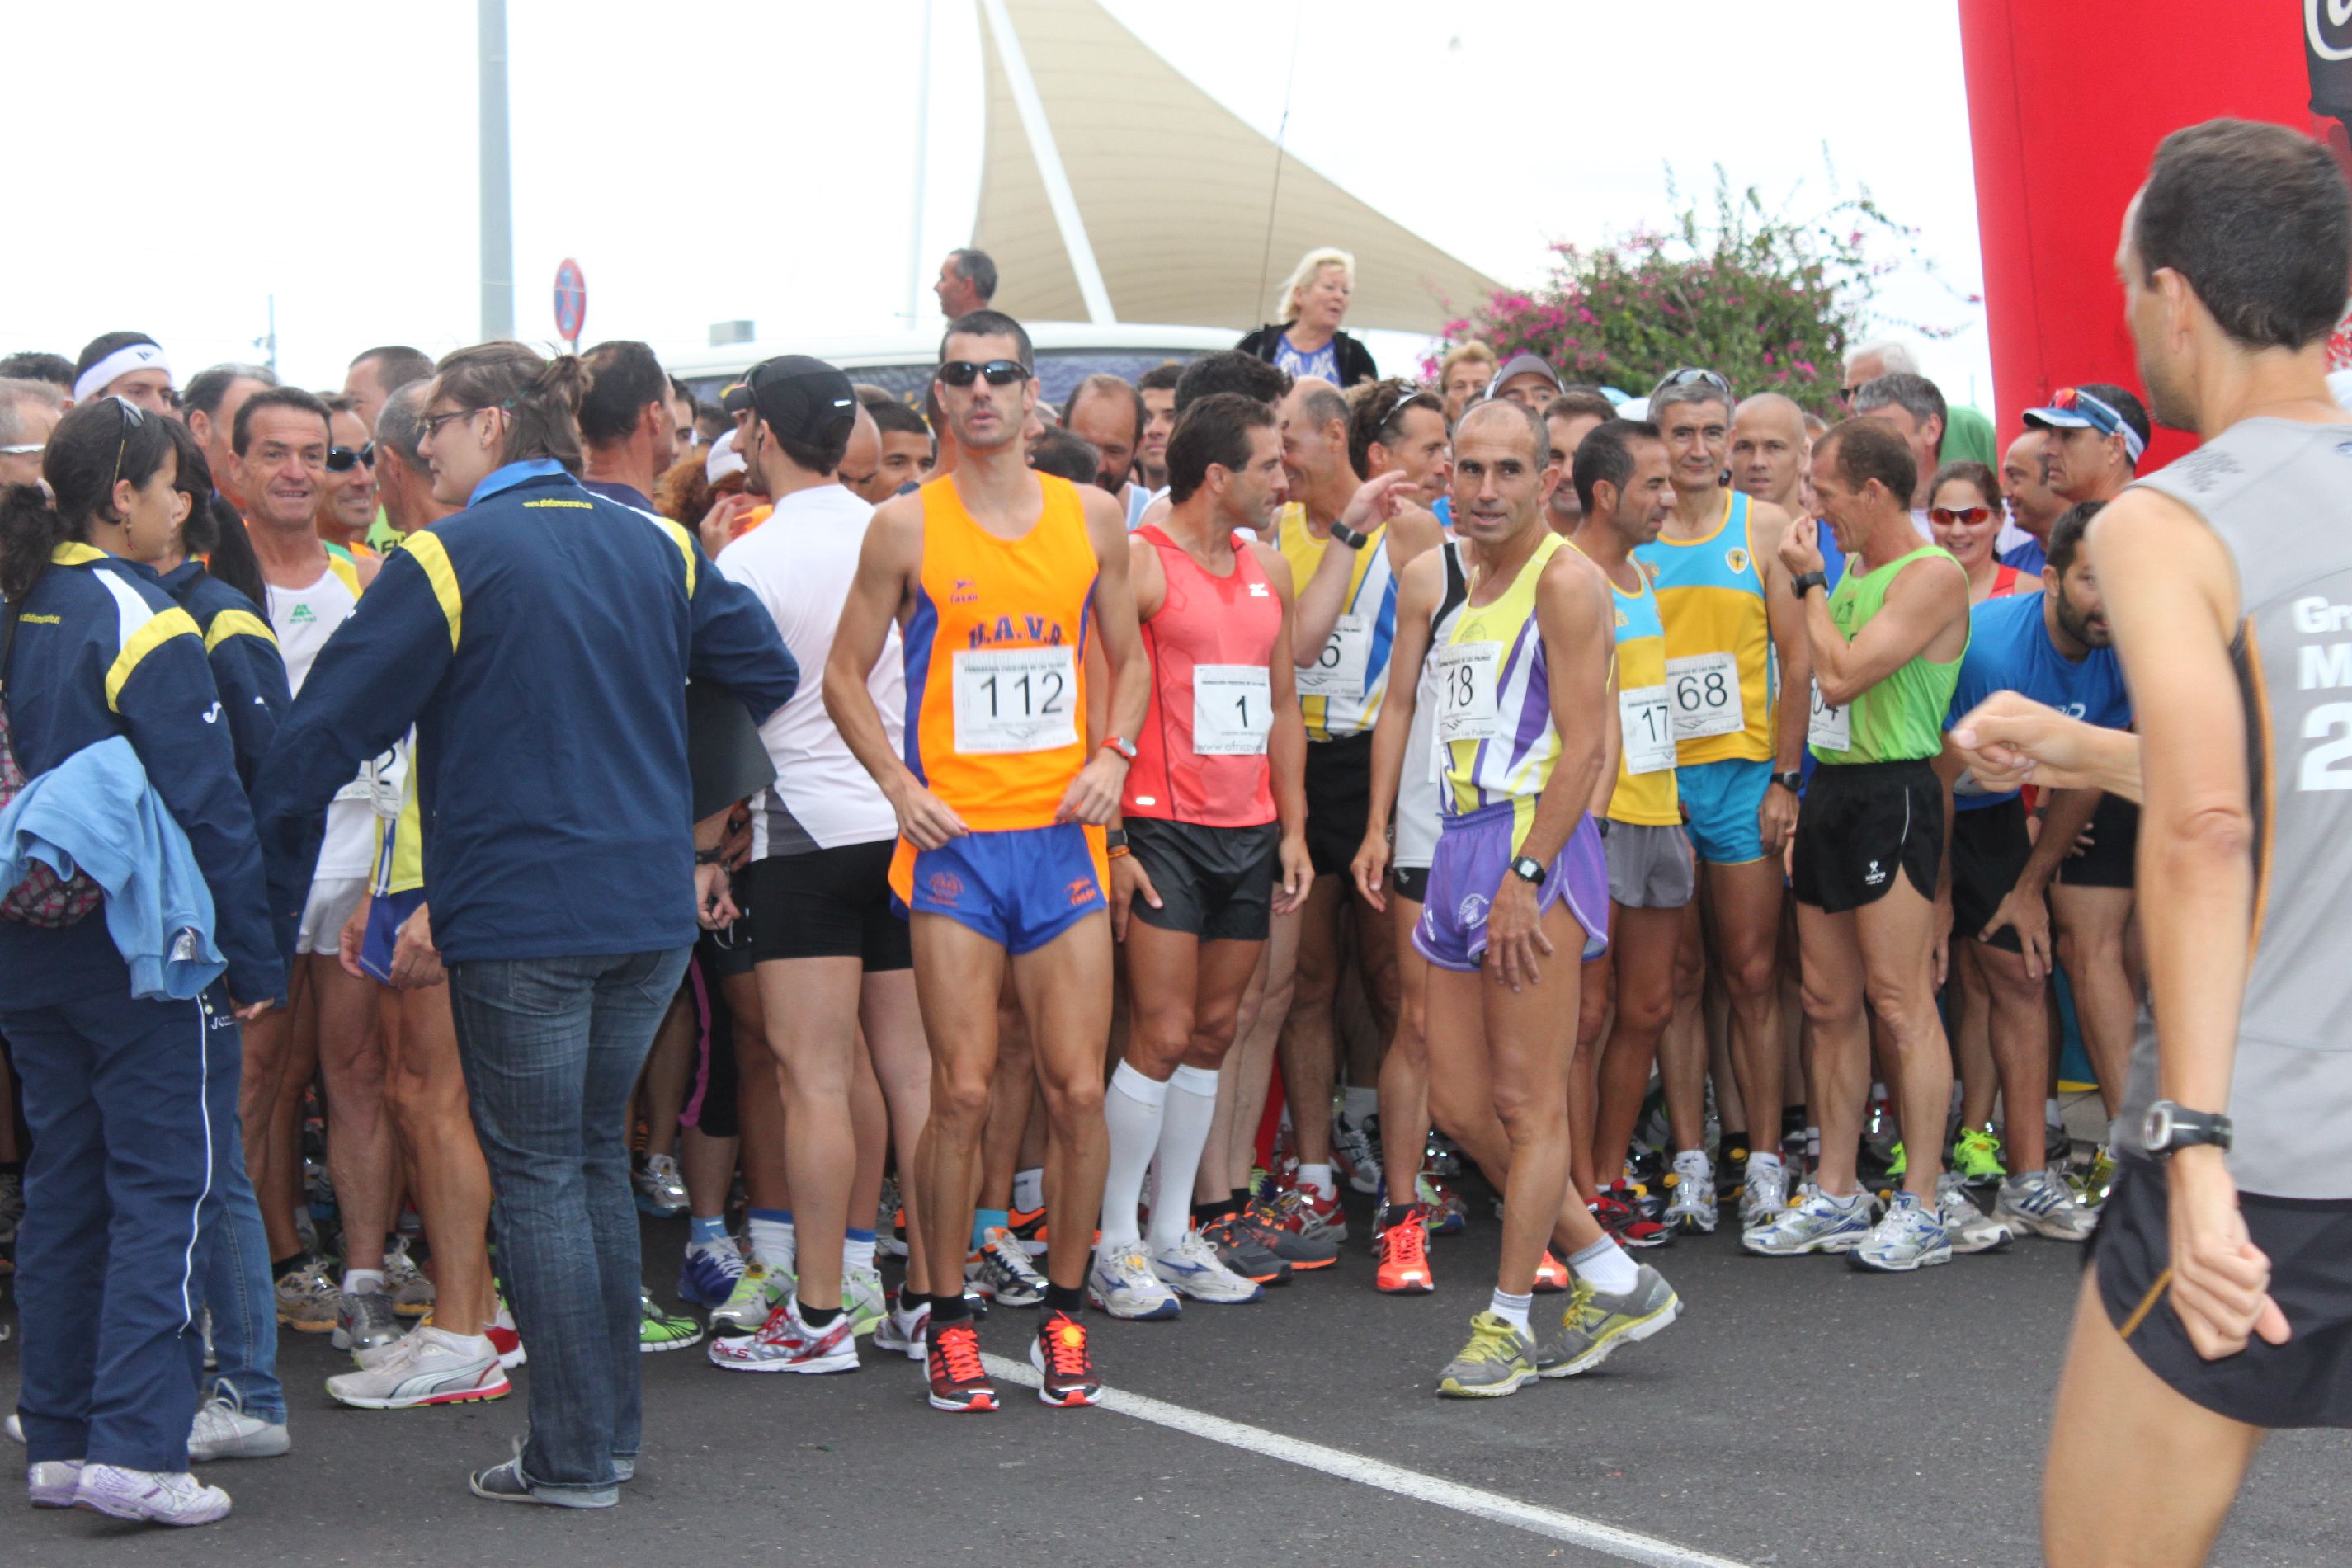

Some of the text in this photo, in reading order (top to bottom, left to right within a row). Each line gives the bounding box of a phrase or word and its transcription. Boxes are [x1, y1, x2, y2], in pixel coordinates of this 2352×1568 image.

[2293, 596, 2352, 633] Gr
[980, 671, 1063, 718] 112
[1447, 665, 1473, 709] 18
[1677, 672, 1728, 711] 68
[1236, 695, 1248, 728] 1
[1642, 706, 1668, 742] 17
